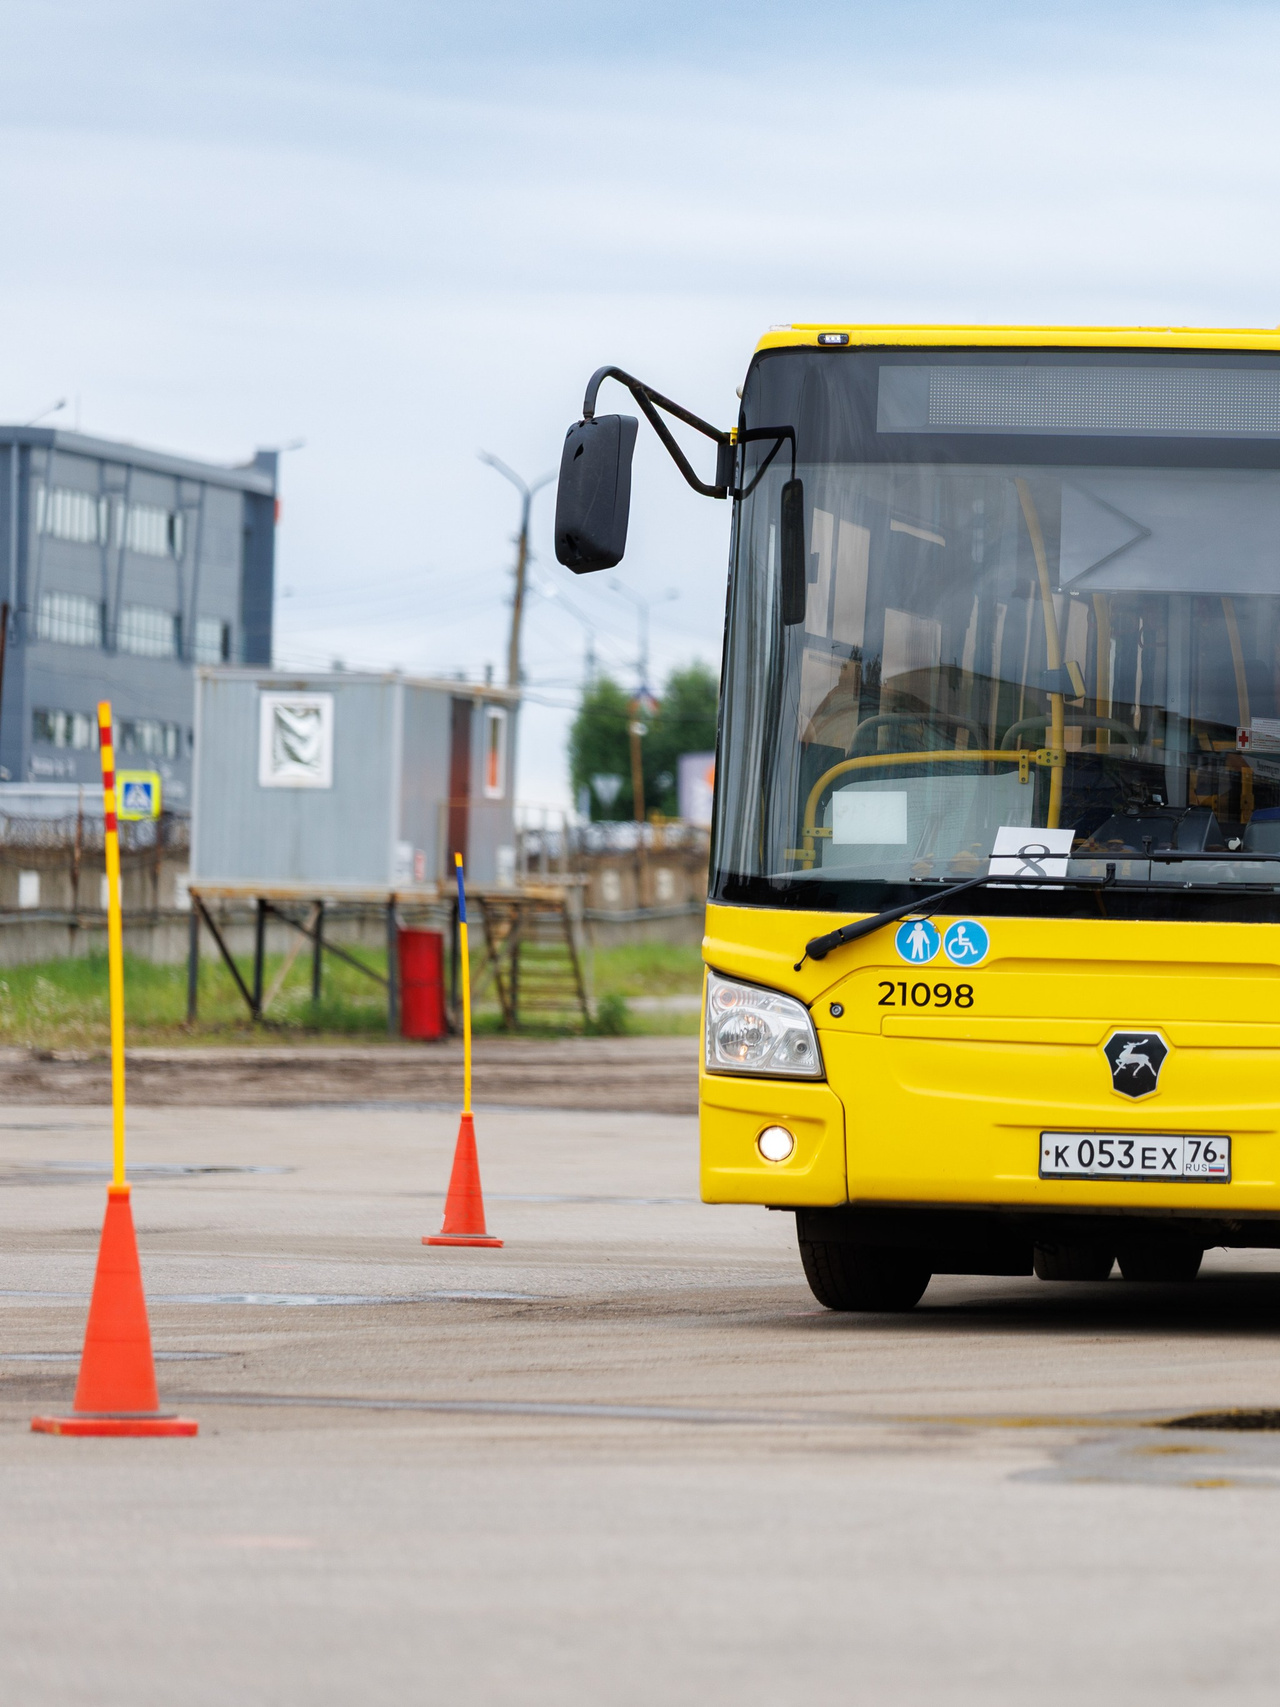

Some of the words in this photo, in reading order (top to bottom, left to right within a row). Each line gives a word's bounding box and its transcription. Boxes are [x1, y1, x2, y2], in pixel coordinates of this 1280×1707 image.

[1013, 843, 1051, 890] 8
[878, 981, 974, 1008] 21098
[1188, 1140, 1217, 1163] 76
[1185, 1163, 1208, 1172] RUS
